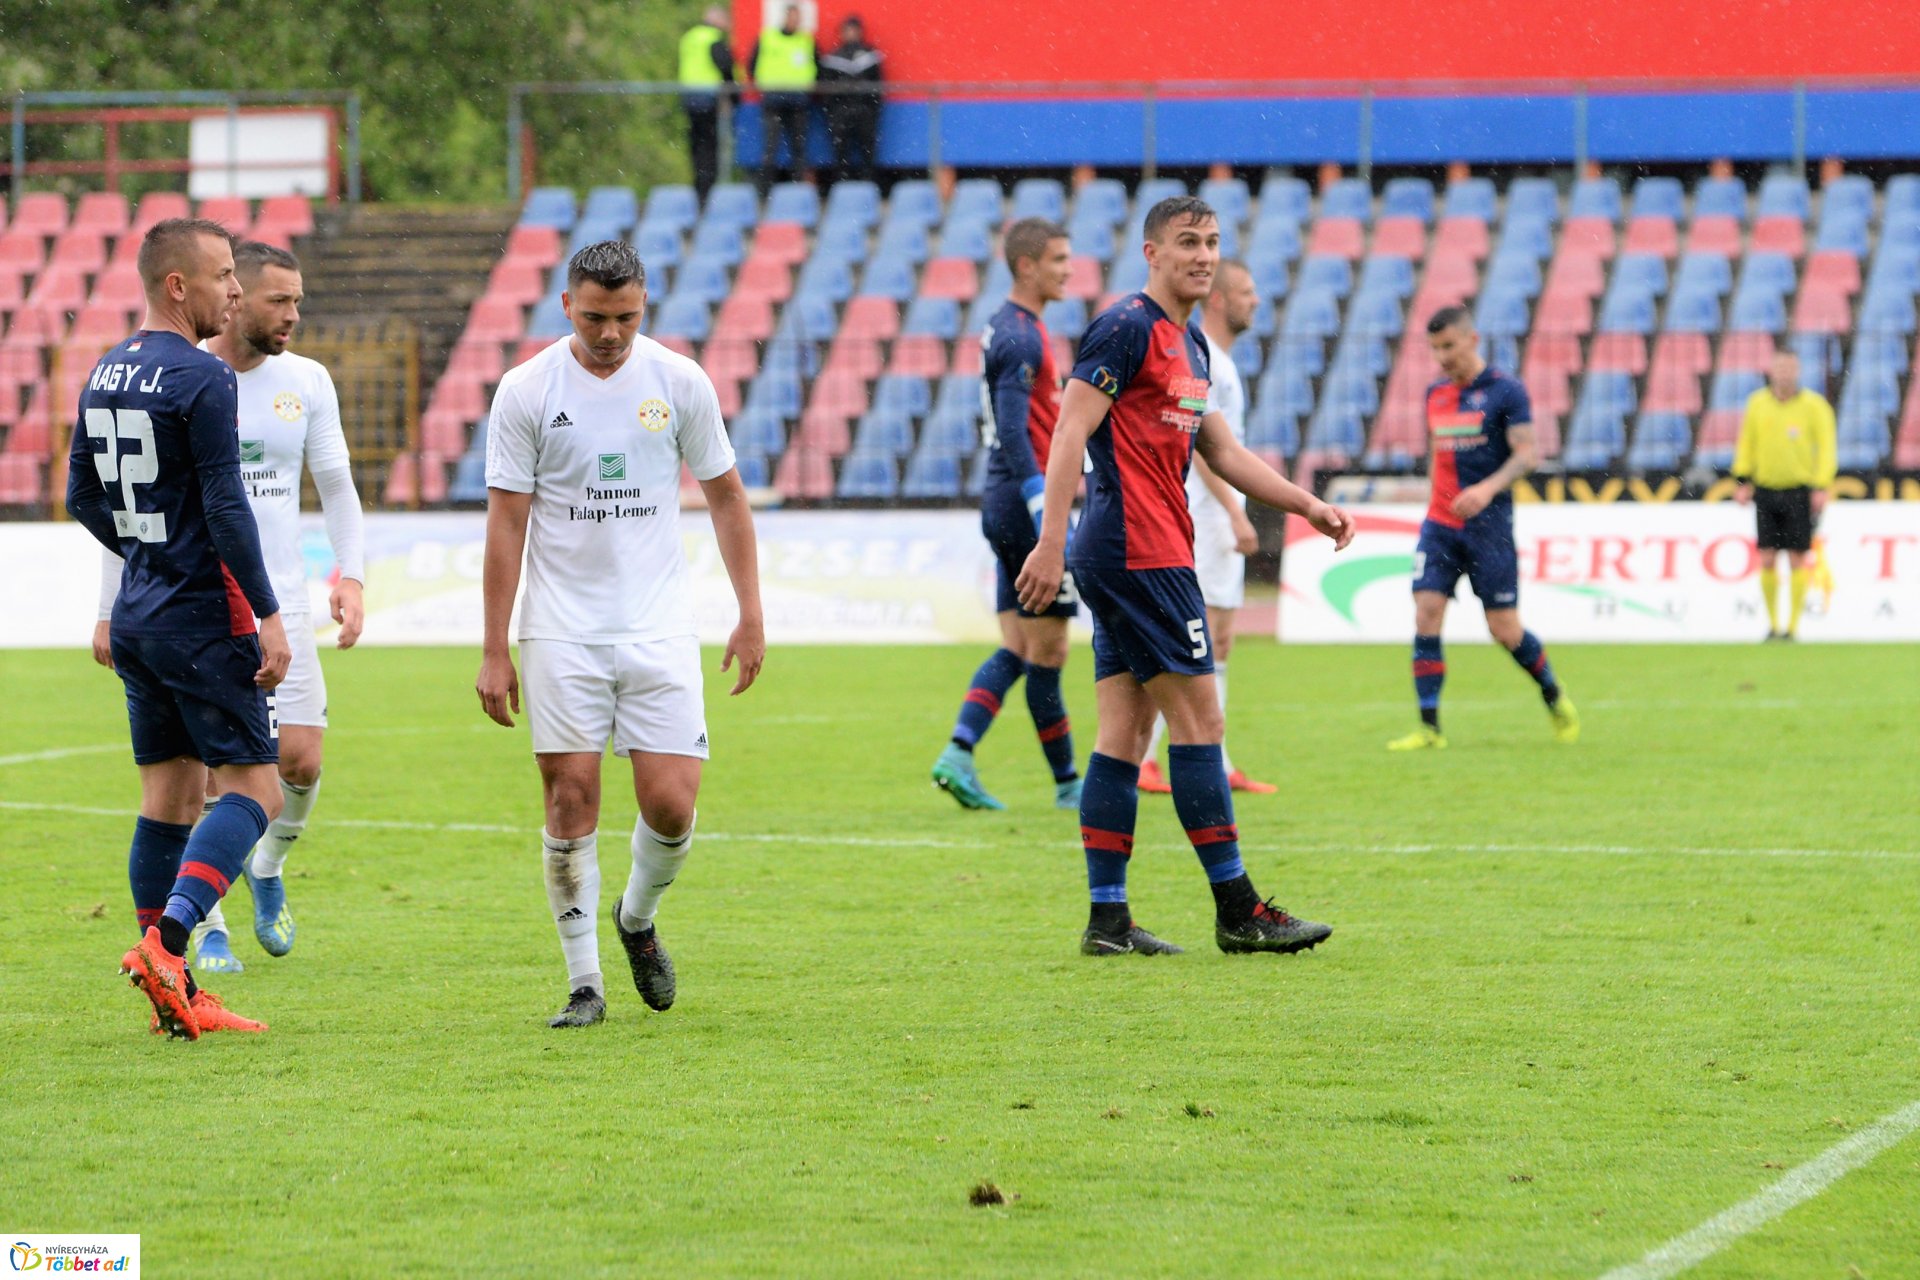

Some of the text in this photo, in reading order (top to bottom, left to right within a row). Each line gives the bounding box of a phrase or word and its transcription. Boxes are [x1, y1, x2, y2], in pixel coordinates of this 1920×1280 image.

[90, 364, 163, 393] NAGY J.
[85, 408, 167, 543] 22
[242, 469, 278, 481] nnon
[586, 487, 641, 500] Pannon
[569, 505, 658, 523] Falap-Lemez
[1186, 619, 1208, 659] 5
